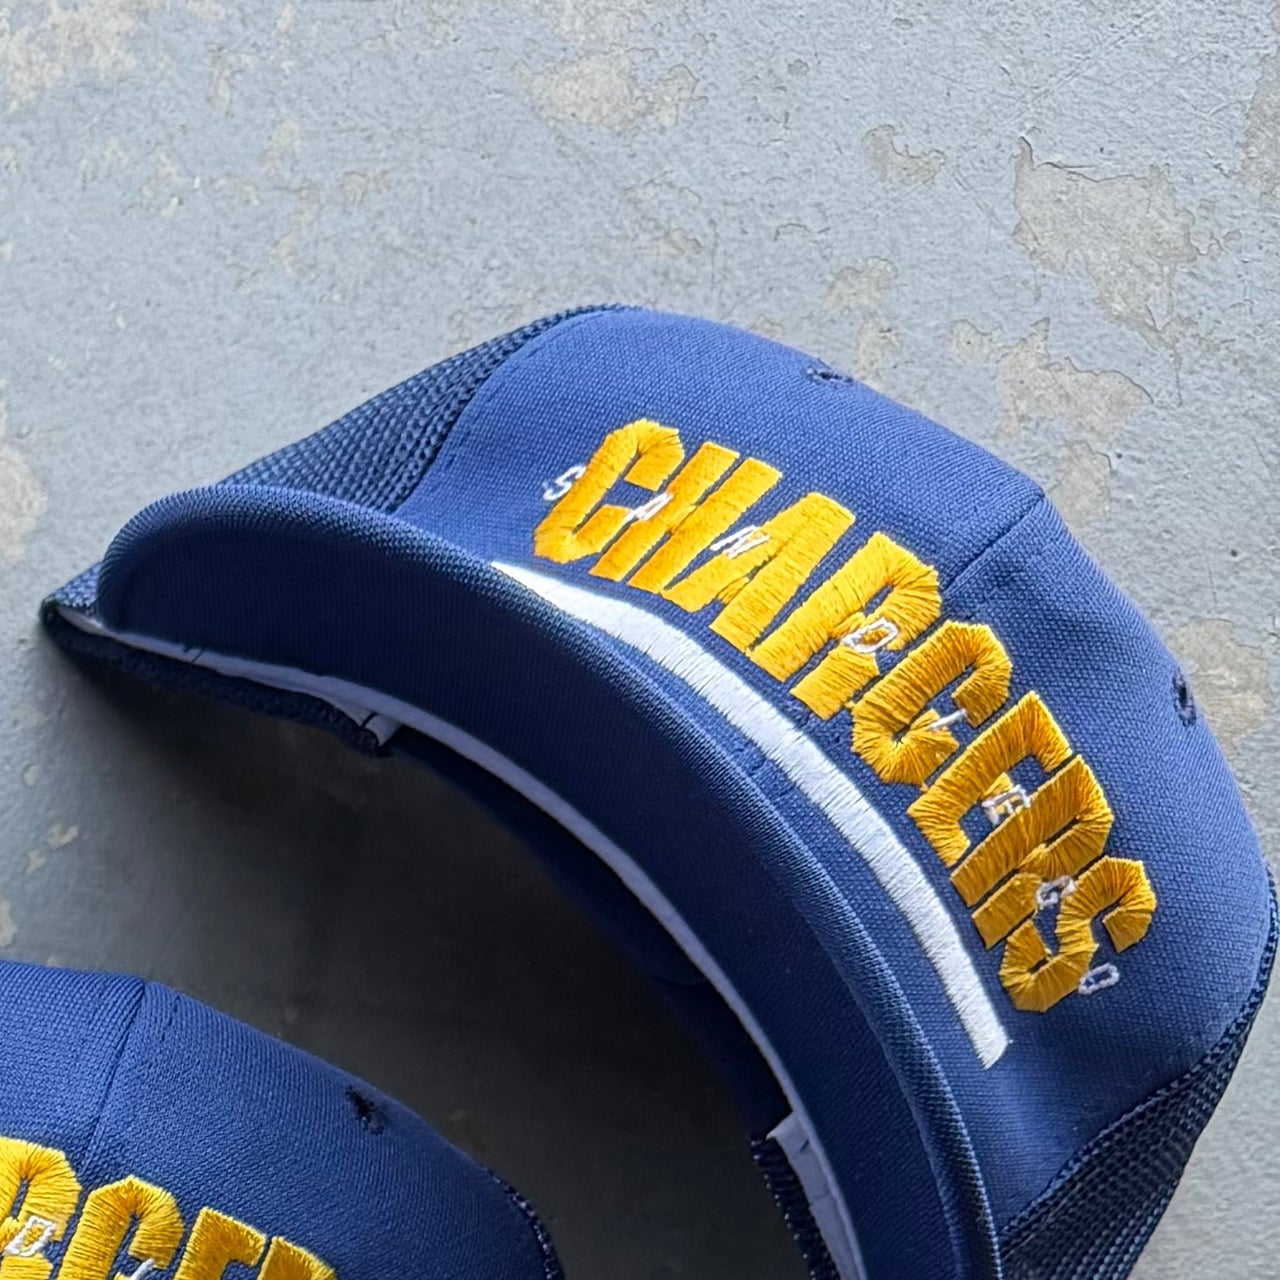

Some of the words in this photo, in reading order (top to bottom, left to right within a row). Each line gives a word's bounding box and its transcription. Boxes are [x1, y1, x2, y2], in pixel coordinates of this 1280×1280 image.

[534, 419, 1156, 1013] CHARGERS
[543, 465, 769, 559] SAN
[843, 617, 1120, 995] DIEGO
